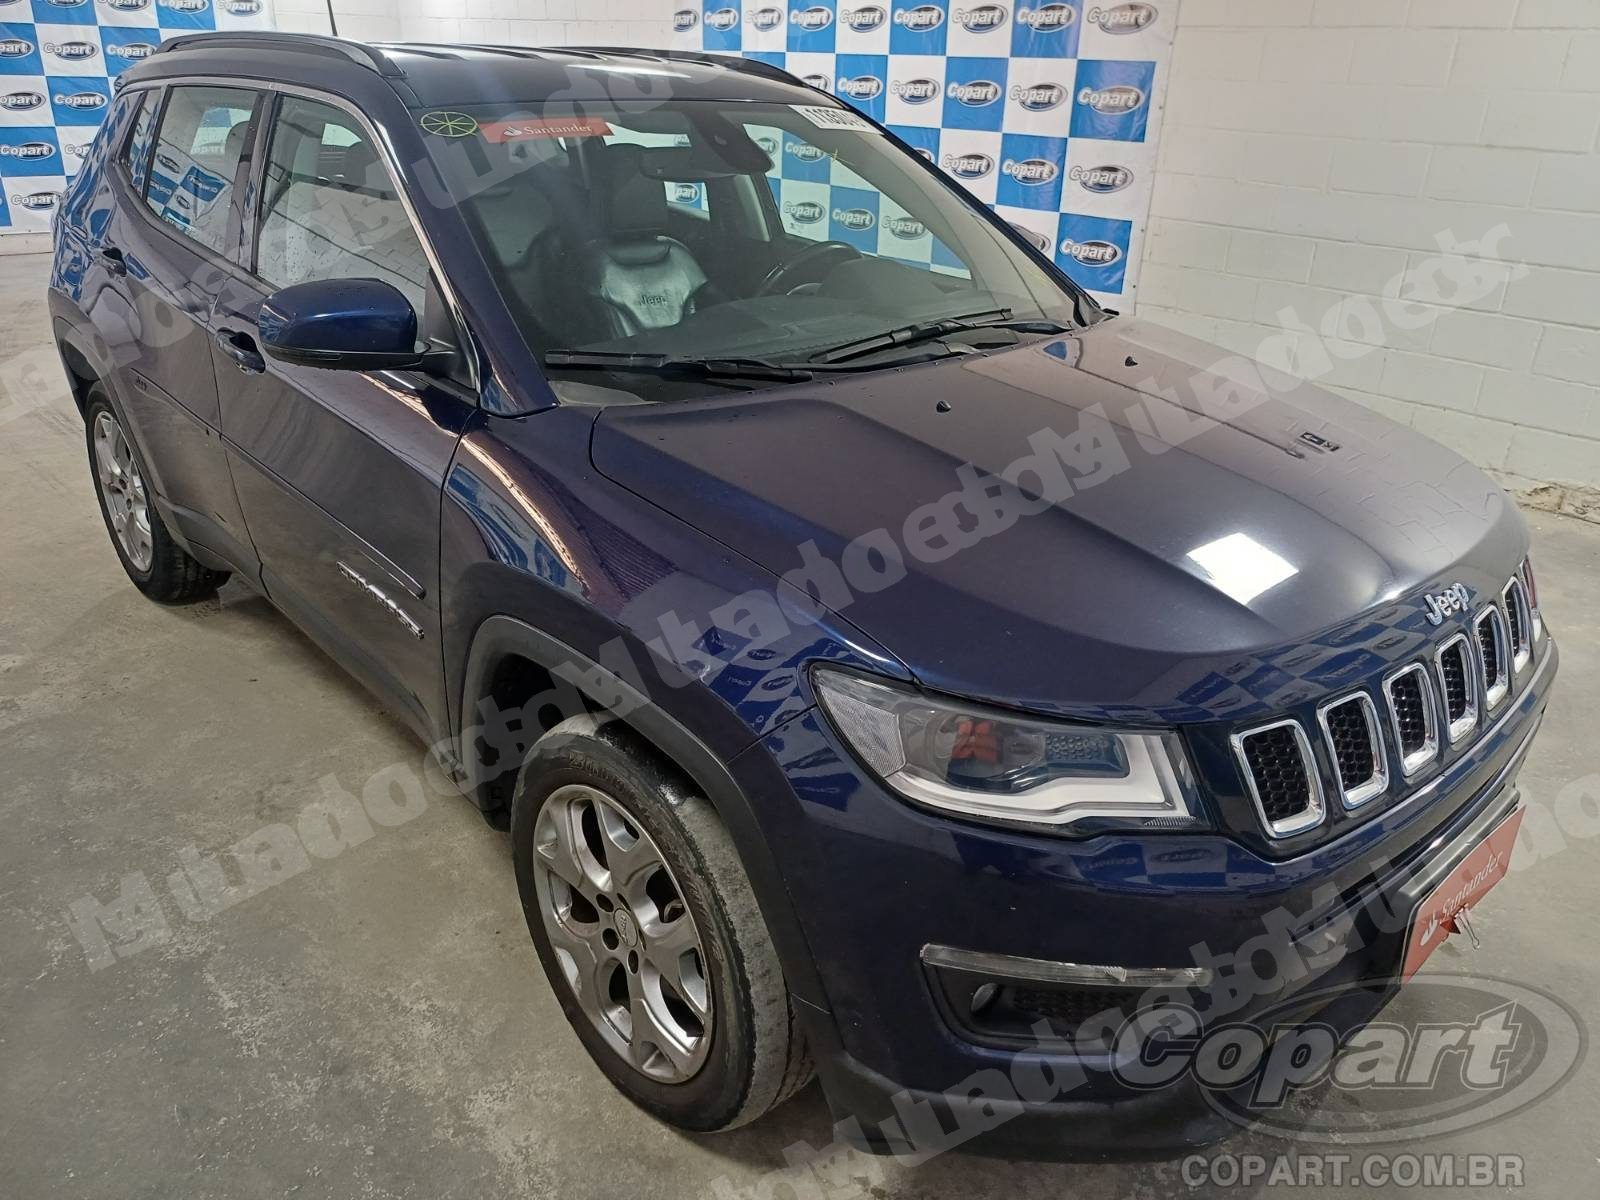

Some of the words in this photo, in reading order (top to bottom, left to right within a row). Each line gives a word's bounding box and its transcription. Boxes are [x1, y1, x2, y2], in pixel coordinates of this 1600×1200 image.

[674, 13, 694, 26] part
[704, 11, 736, 28] Copart
[744, 9, 779, 27] Copart
[790, 9, 829, 27] Copart
[840, 8, 881, 28] Copart
[894, 8, 938, 28] Copart
[952, 7, 1001, 28] Copart
[1017, 6, 1070, 28] Copart
[1088, 7, 1147, 28] Copart
[44, 42, 92, 57] Copart
[106, 44, 153, 58] Copart
[838, 77, 877, 97] Copart
[890, 79, 936, 99] Copart
[947, 81, 996, 102] Copart
[1009, 84, 1059, 105] Copart
[1078, 86, 1139, 108] Copart
[0, 94, 40, 107] opart
[54, 93, 103, 108] Copart
[524, 124, 593, 137] Santander
[0, 143, 49, 157] Copart
[65, 143, 91, 157] Cop
[942, 153, 988, 172] Copart
[1002, 158, 1051, 180] Copart
[1069, 164, 1124, 186] Copart
[11, 192, 58, 207] Copart
[783, 200, 821, 219] Copart
[832, 208, 870, 227] Copart
[881, 215, 924, 237] Copart
[1059, 238, 1115, 262] Copart
[1423, 582, 1470, 626] Jeep
[1442, 850, 1504, 919] Santander
